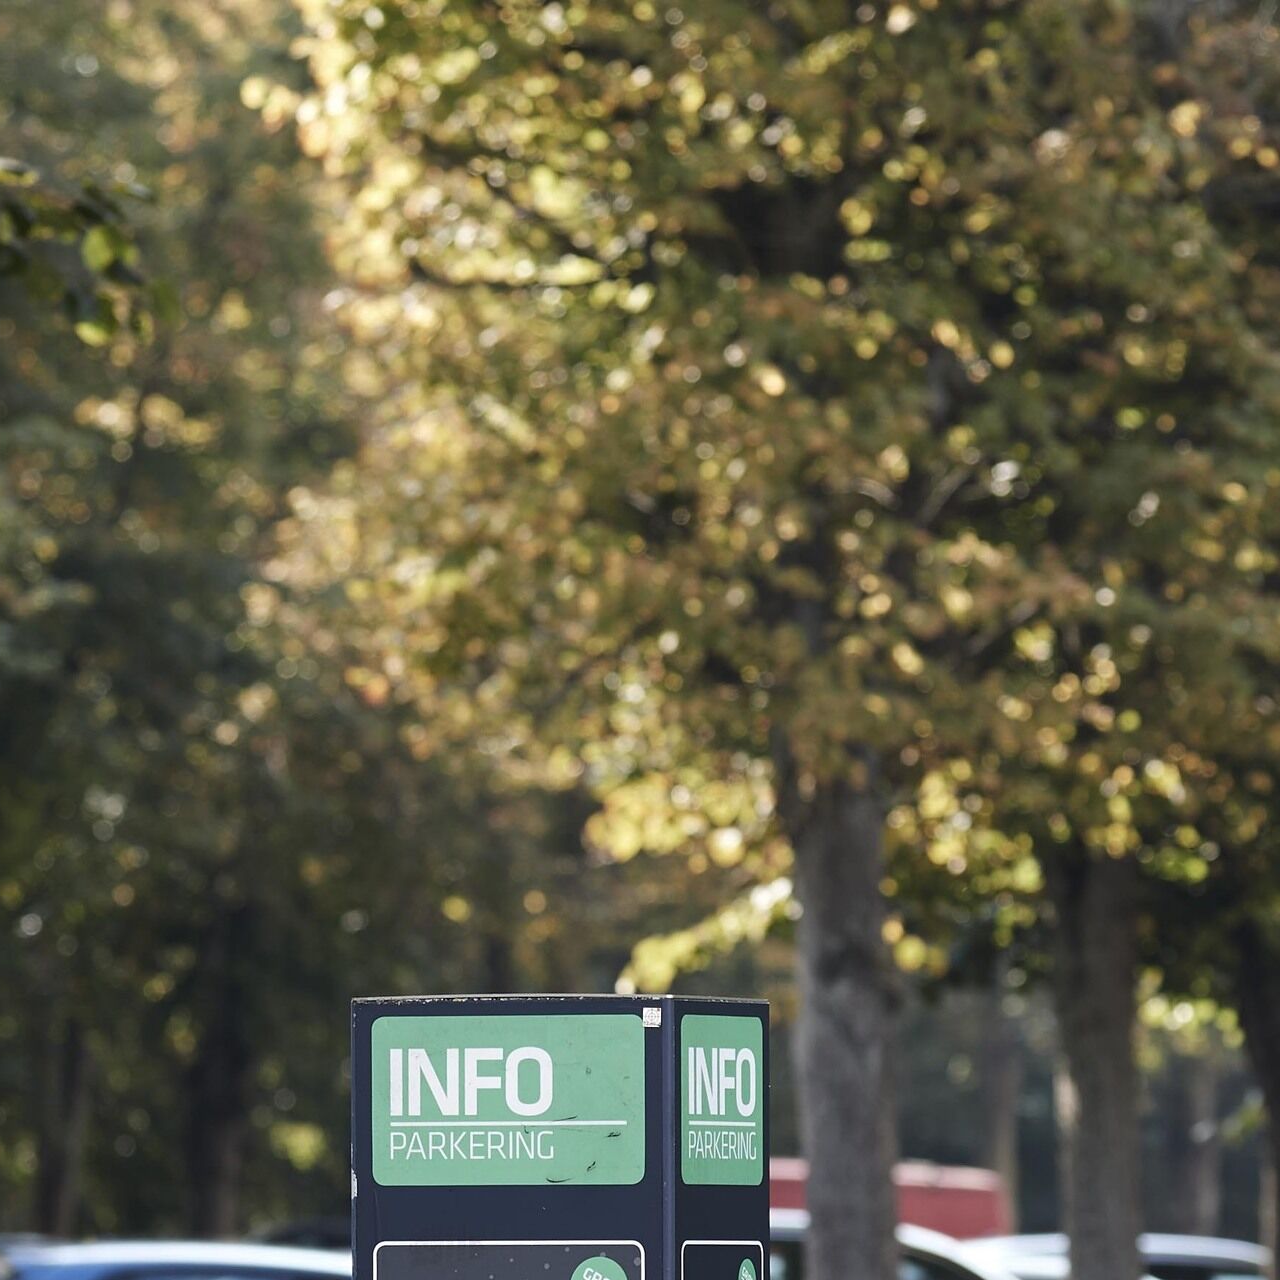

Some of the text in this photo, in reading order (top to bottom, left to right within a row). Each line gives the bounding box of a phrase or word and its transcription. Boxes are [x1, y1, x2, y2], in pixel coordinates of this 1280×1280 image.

[390, 1046, 554, 1117] INFO
[688, 1046, 756, 1117] INFO
[390, 1130, 554, 1160] PARKERING
[688, 1130, 757, 1160] PARKERING
